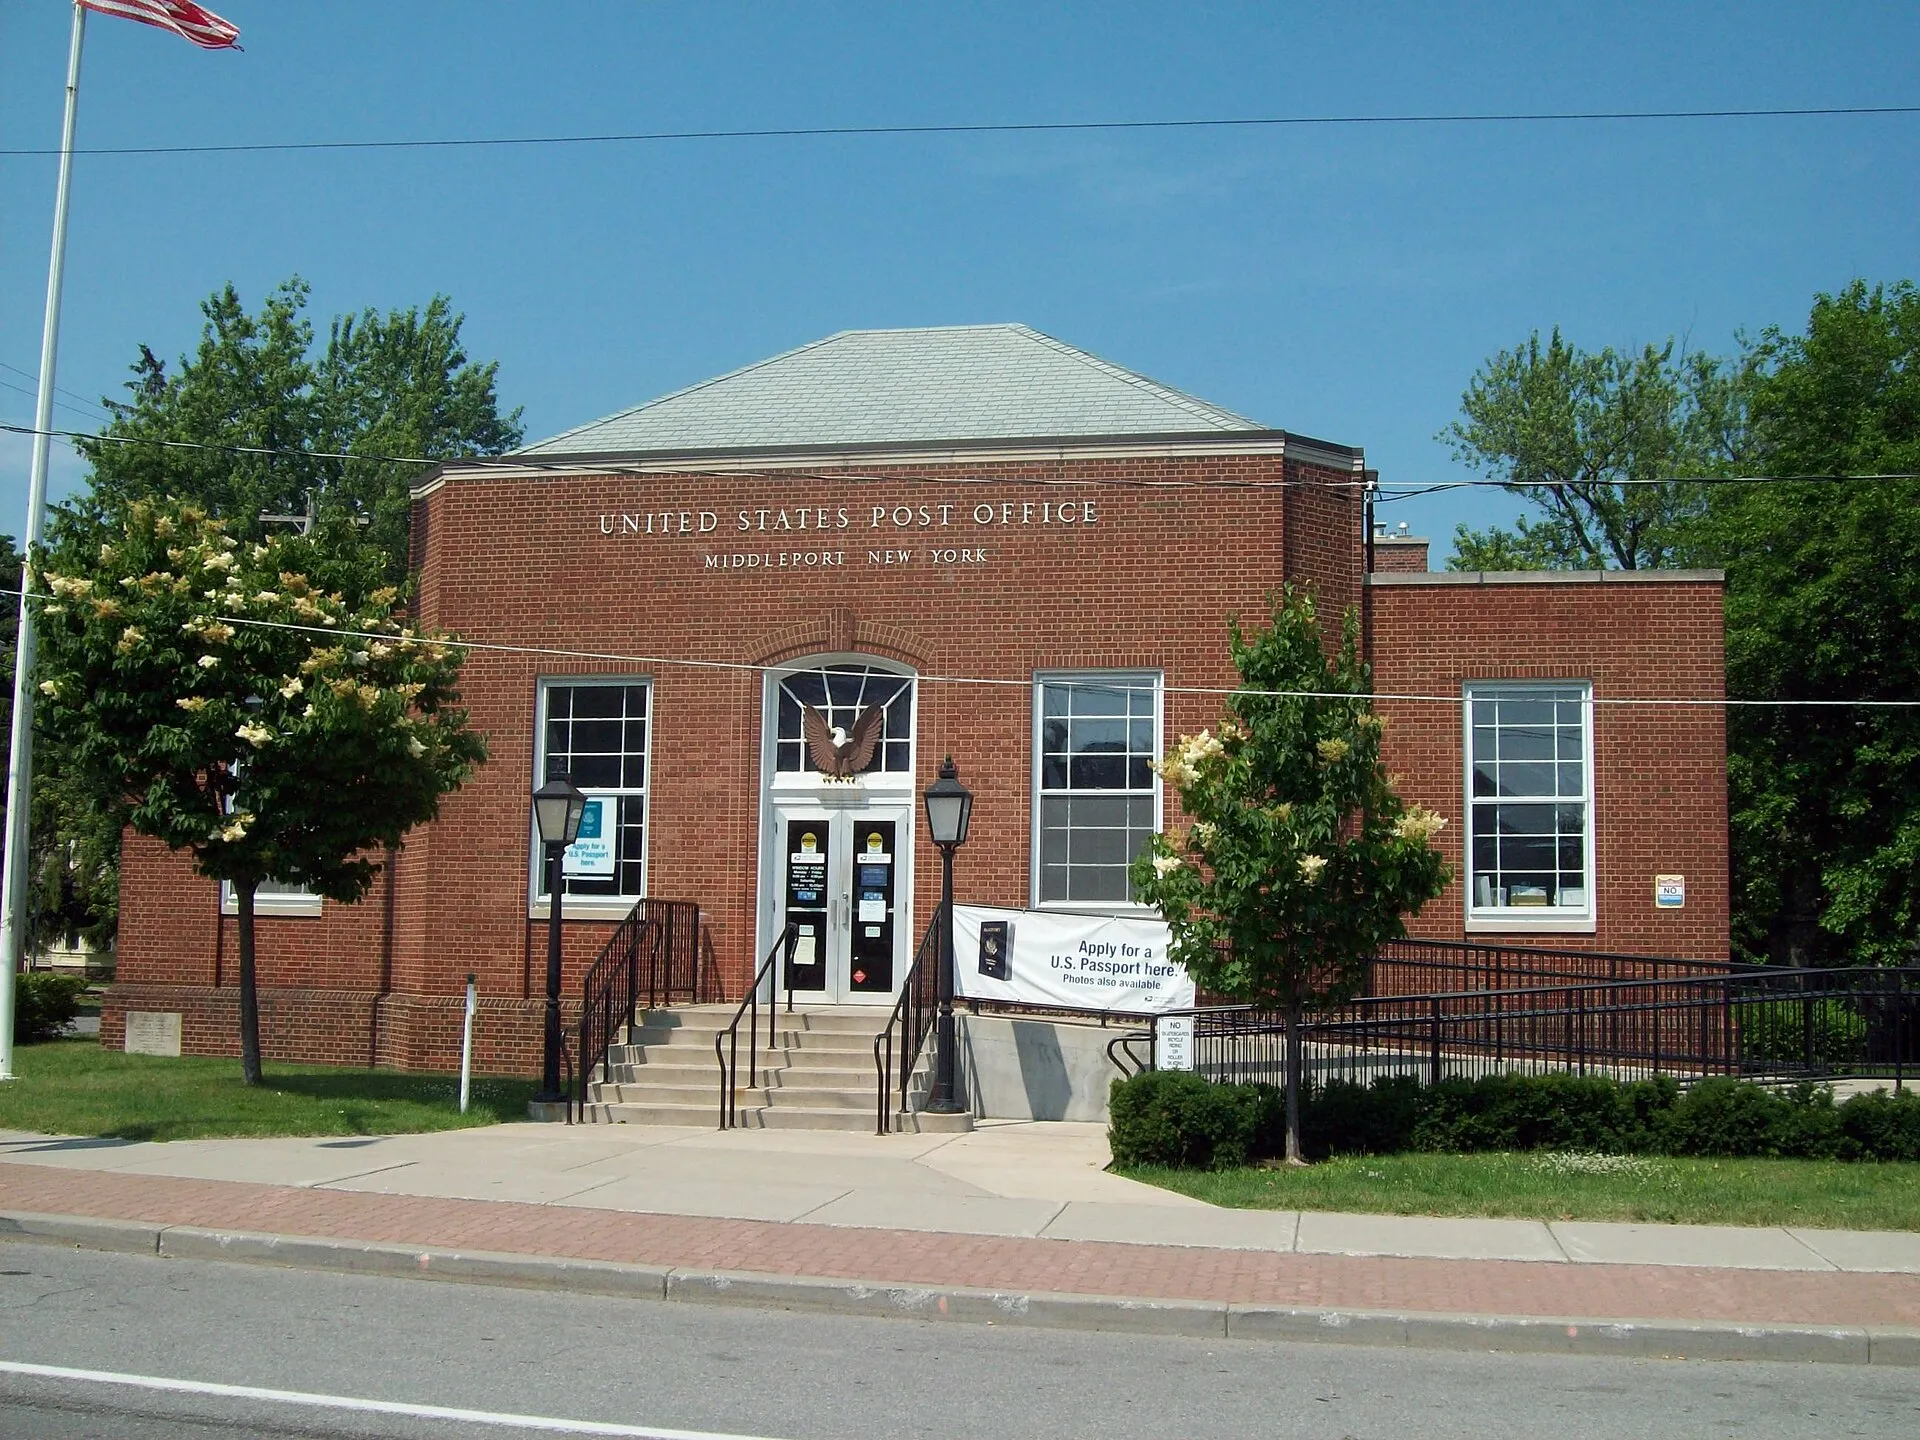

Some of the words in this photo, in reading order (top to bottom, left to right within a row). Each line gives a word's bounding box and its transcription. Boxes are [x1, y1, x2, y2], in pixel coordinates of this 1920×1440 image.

[600, 511, 718, 534] UNITED
[737, 508, 849, 531] STATES
[871, 504, 954, 528] POST
[973, 501, 1099, 525] OFFICE
[705, 551, 845, 568] MIDDLEPORT
[868, 550, 912, 564] NEW
[931, 549, 987, 563] YORK
[1079, 940, 1117, 958] Apply
[1121, 943, 1140, 957] for
[1144, 947, 1152, 958] a
[1051, 955, 1076, 970] U.S.
[1080, 957, 1140, 975] Passport
[1144, 962, 1178, 977] here.
[1063, 973, 1095, 985] Photos
[1097, 977, 1117, 987] also
[1169, 1021, 1181, 1029] NO
